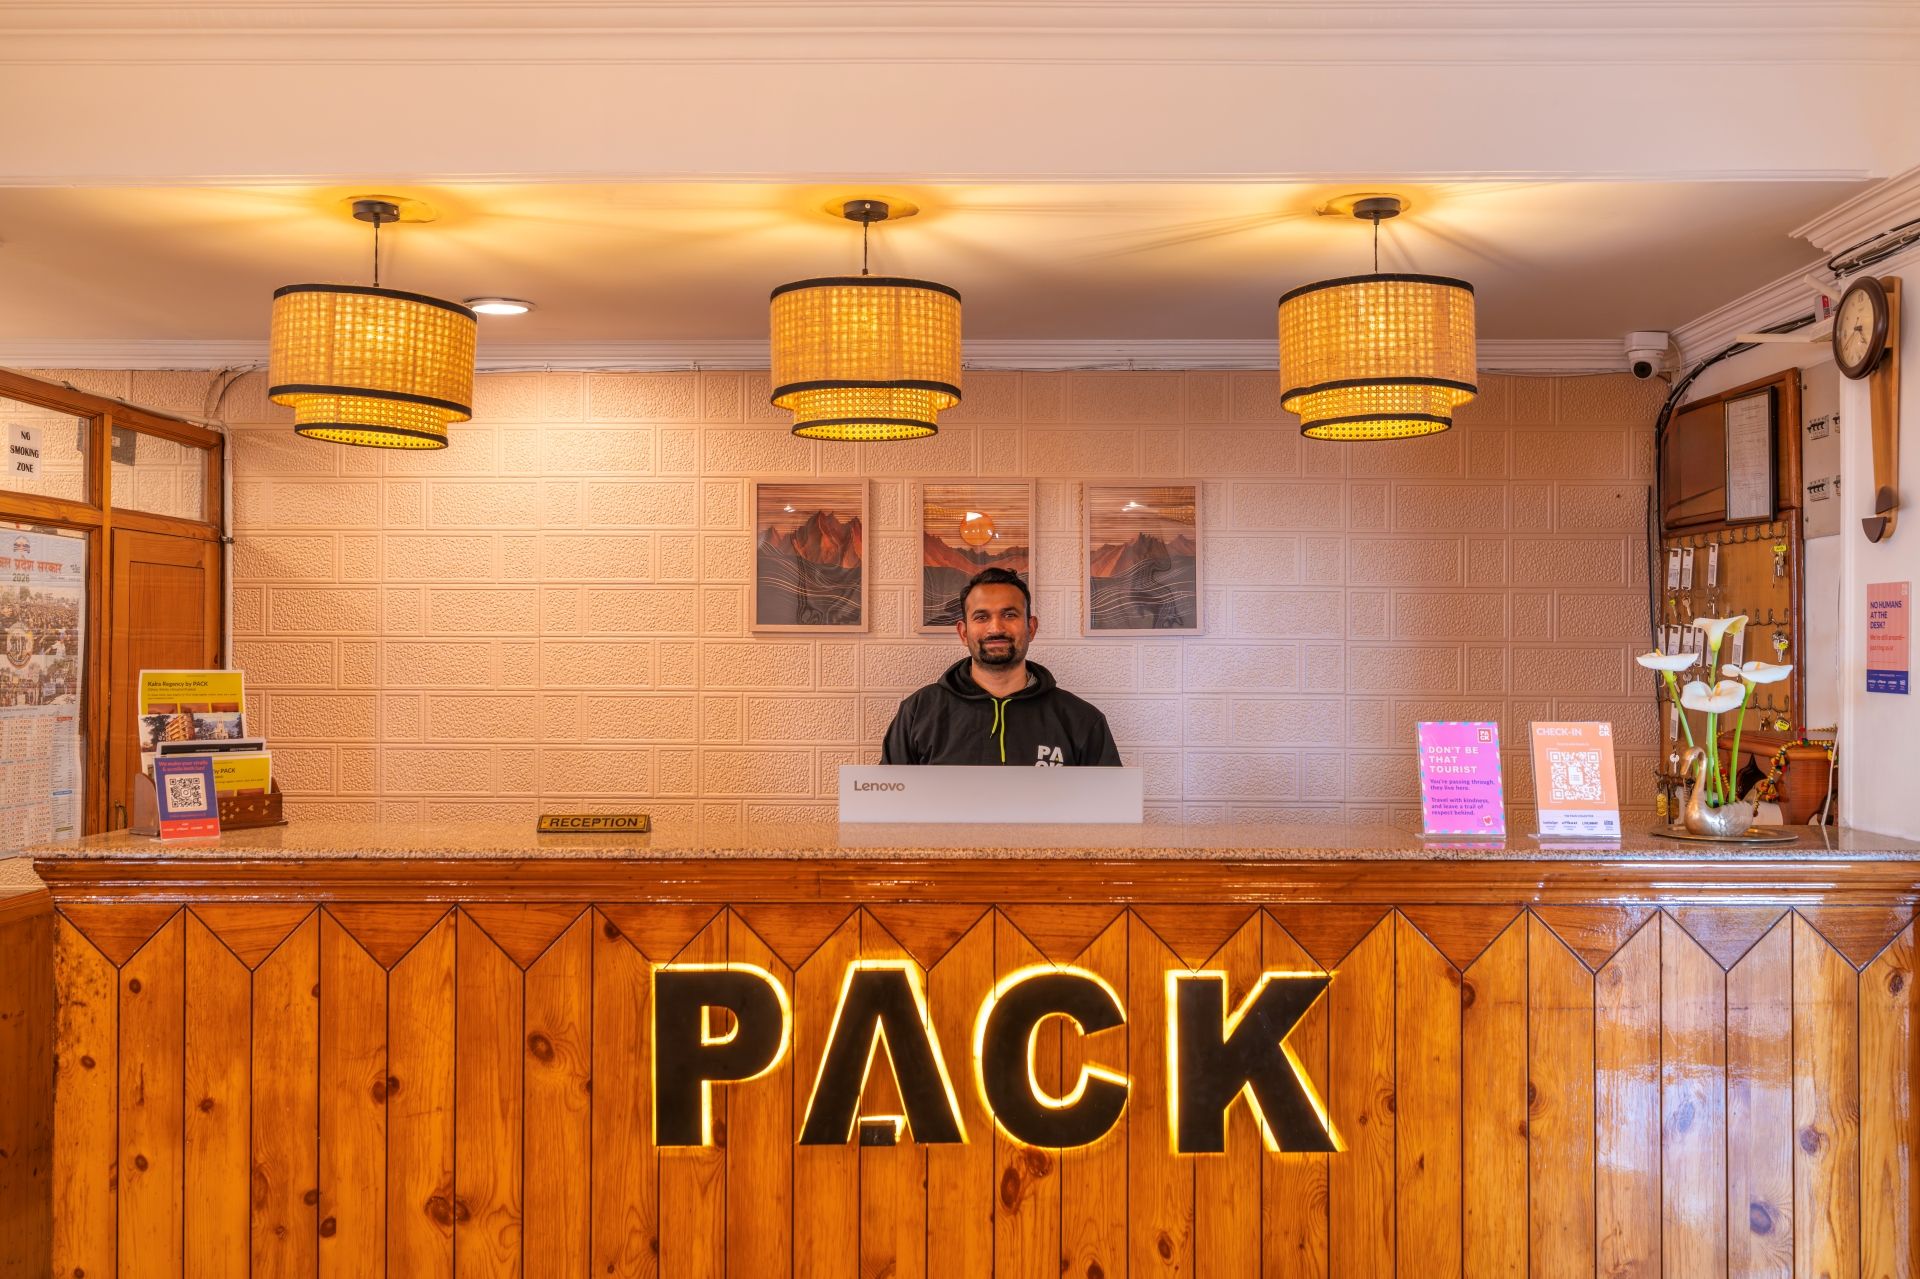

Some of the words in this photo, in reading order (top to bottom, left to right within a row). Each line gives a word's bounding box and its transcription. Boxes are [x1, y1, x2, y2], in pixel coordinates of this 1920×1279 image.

[20, 431, 31, 440] NO
[9, 444, 39, 458] SMOKING
[16, 462, 34, 473] ZONE
[12, 573, 30, 583] 2026
[1870, 601, 1878, 609] NO
[1879, 600, 1902, 609] HUMANS
[1870, 611, 1877, 619] AT
[1878, 611, 1888, 619] THE
[1870, 621, 1886, 629] DESK?
[185, 681, 192, 689] by
[1536, 728, 1582, 737] CHECK-IN
[1037, 745, 1064, 762] PA
[1428, 746, 1461, 754] DON'T
[1465, 746, 1479, 754] BE
[1429, 756, 1458, 764] THAT
[853, 780, 905, 792] Lenovo
[549, 817, 638, 828] RECEPTION
[654, 959, 1343, 1154] PACK
